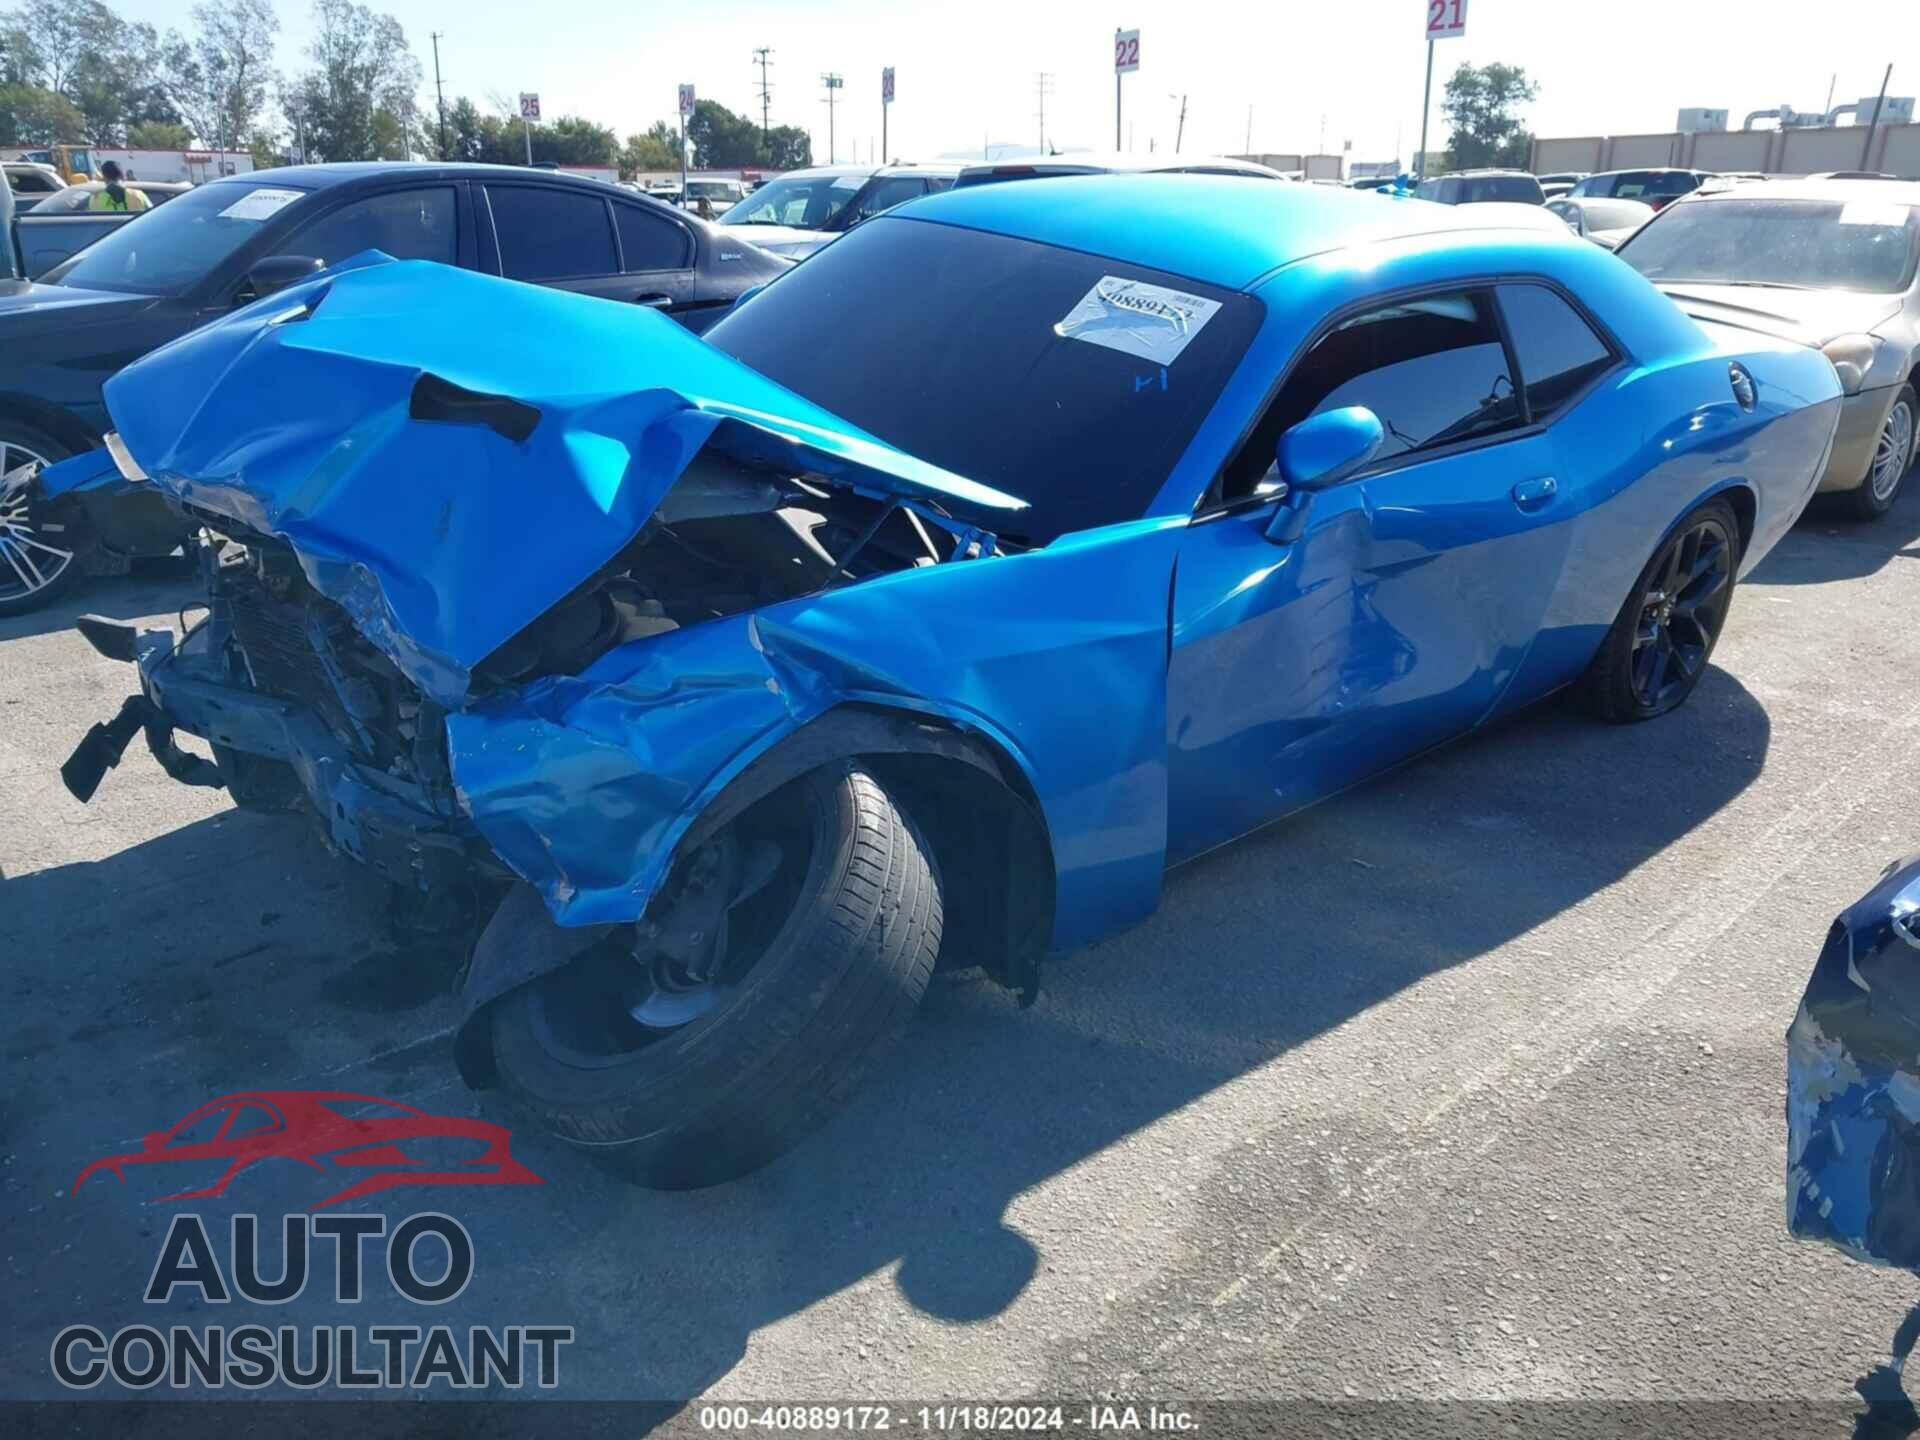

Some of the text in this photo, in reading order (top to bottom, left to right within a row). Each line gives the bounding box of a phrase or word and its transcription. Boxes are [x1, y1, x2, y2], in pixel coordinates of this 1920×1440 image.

[1428, 0, 1464, 31] 21
[1116, 38, 1139, 66] 22
[521, 97, 540, 117] 25
[680, 89, 694, 111] 24
